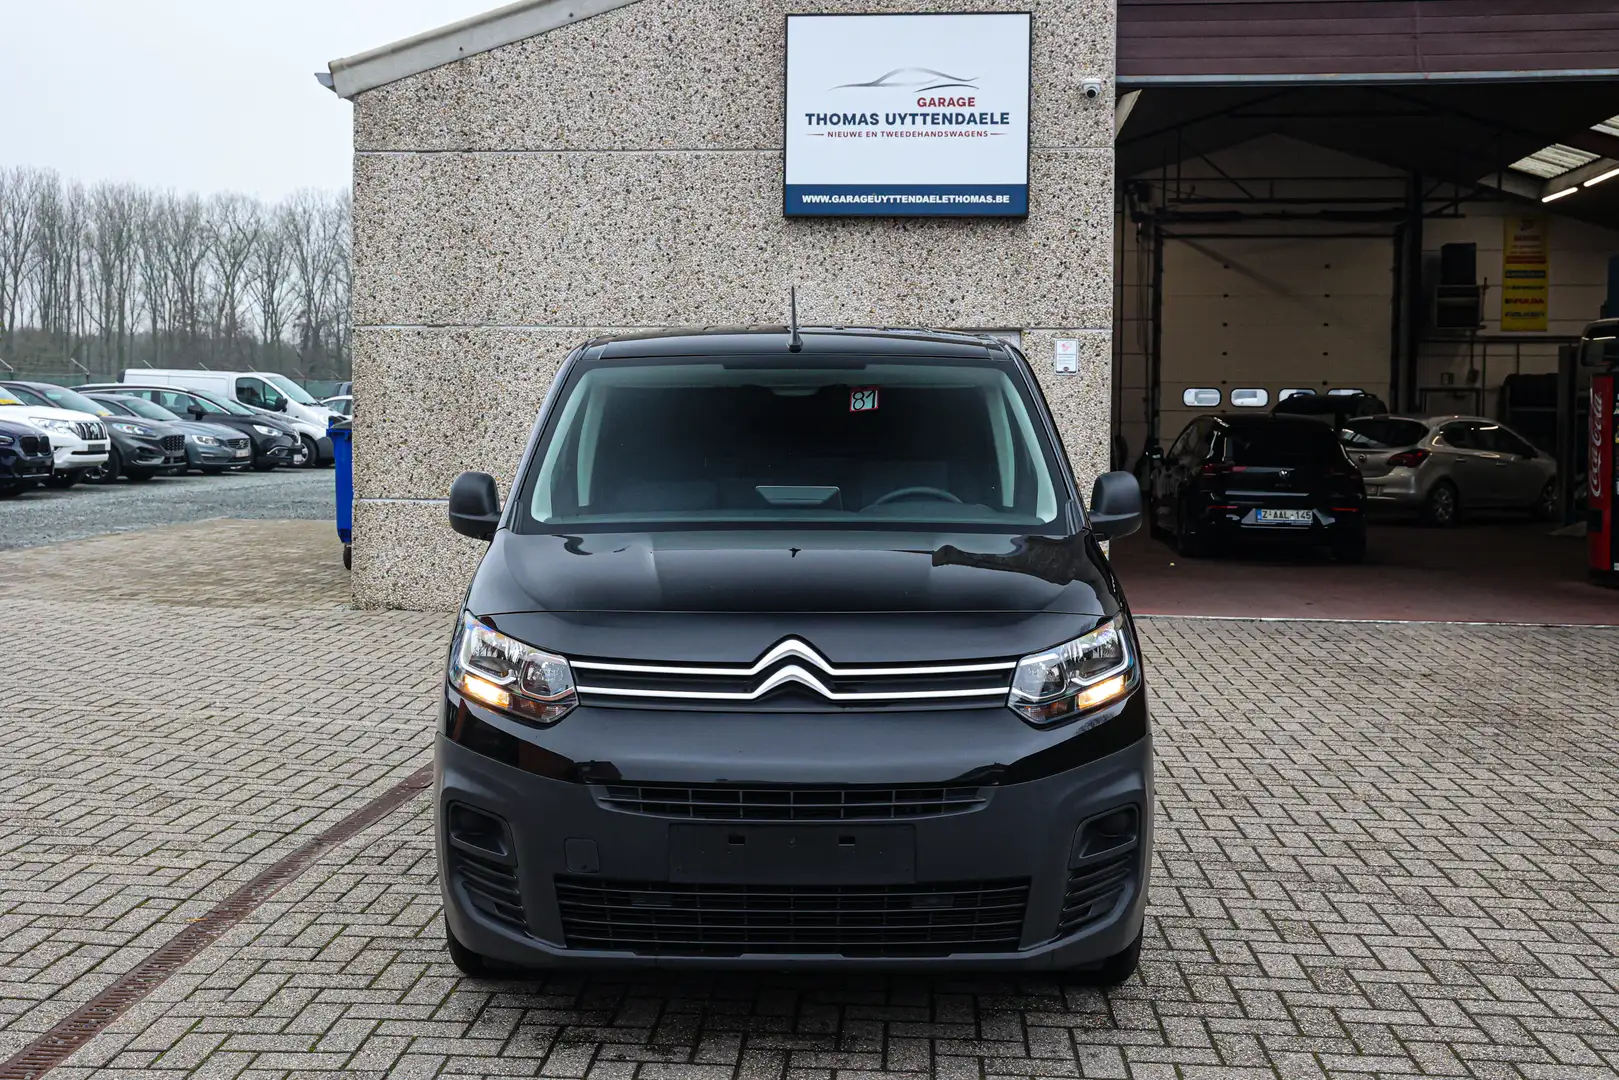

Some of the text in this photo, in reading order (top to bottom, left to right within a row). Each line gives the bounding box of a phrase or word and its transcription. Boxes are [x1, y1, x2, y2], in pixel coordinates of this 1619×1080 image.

[917, 97, 975, 107] GARAGE
[805, 112, 1010, 126] THOMAS UYTTENDAELE
[881, 130, 988, 138] TWEEDEHANDSWAGENS
[801, 194, 1010, 203] WWW.GARAGEUYTTENDAELETHOMAS.BE
[852, 391, 876, 411] 81
